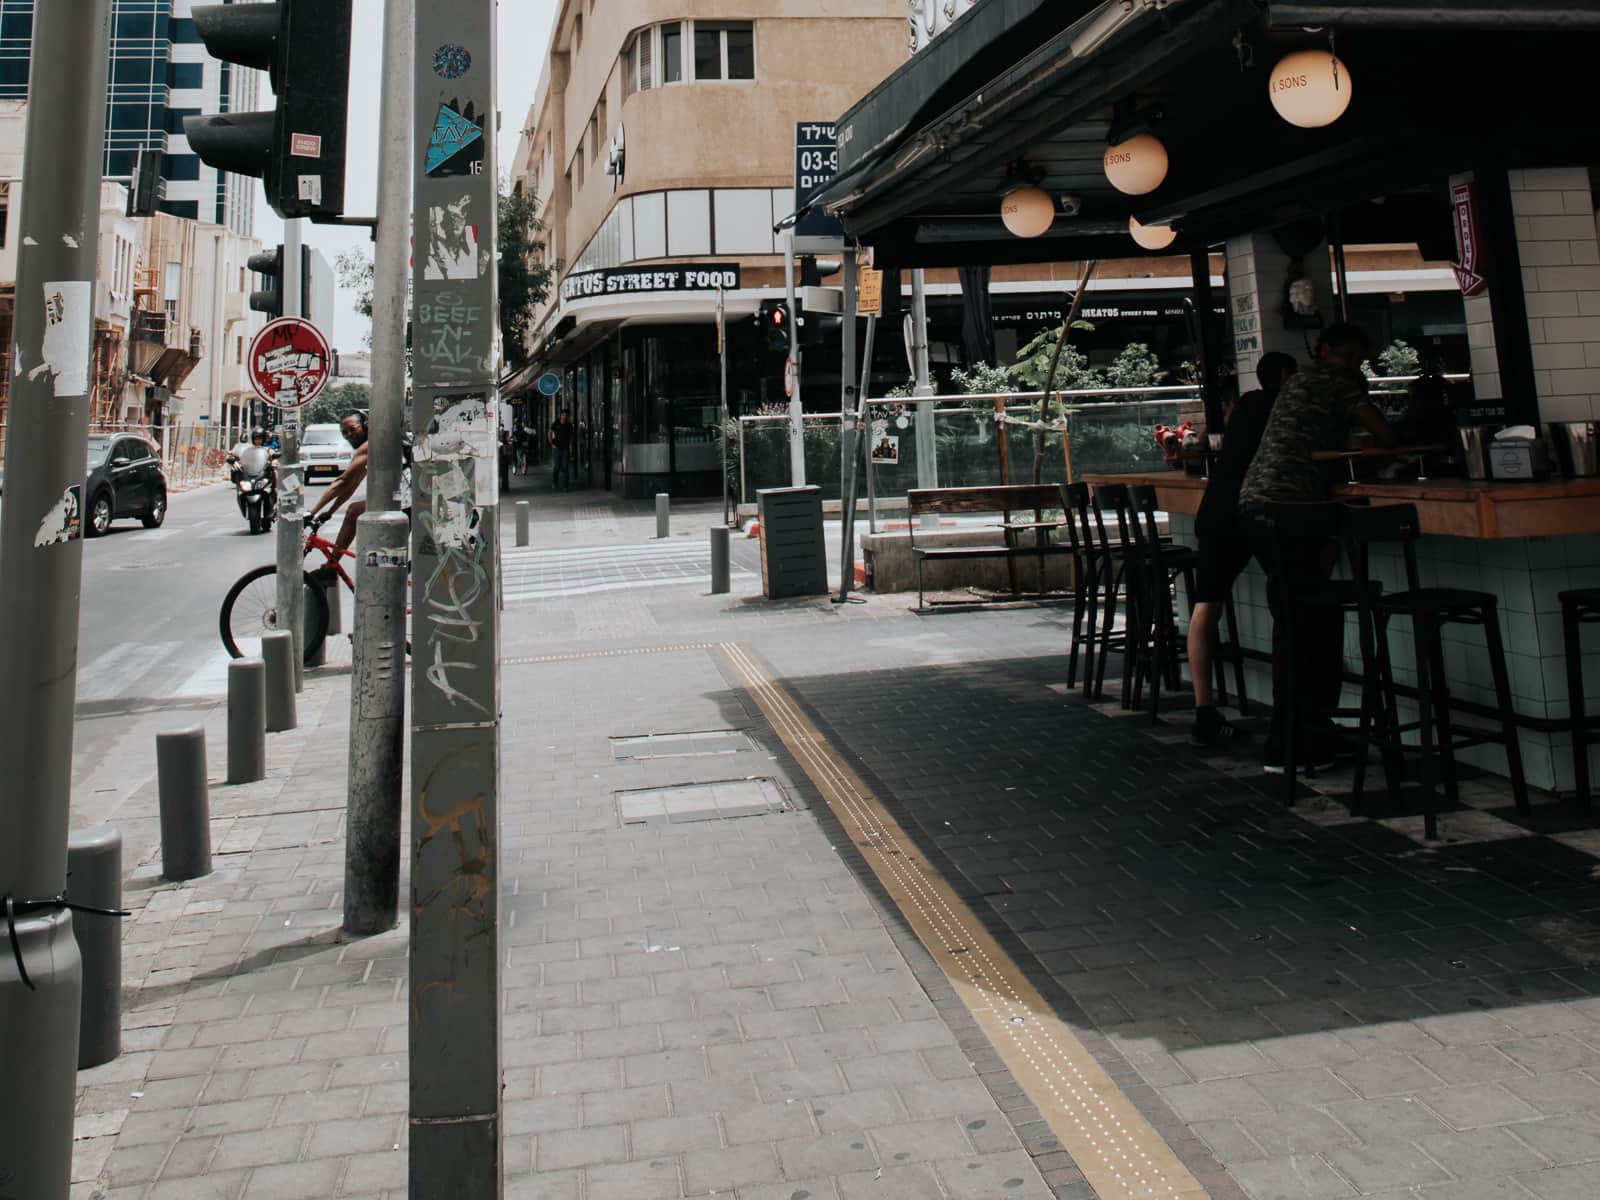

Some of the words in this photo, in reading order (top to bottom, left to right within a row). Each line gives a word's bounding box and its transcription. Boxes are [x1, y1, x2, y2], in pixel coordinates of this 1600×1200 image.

[1279, 75, 1308, 91] SONS
[1109, 153, 1132, 166] SONS
[606, 272, 679, 292] STREET
[685, 271, 736, 288] FOOD
[420, 304, 482, 324] BEEF
[1081, 308, 1120, 318] MEATOS
